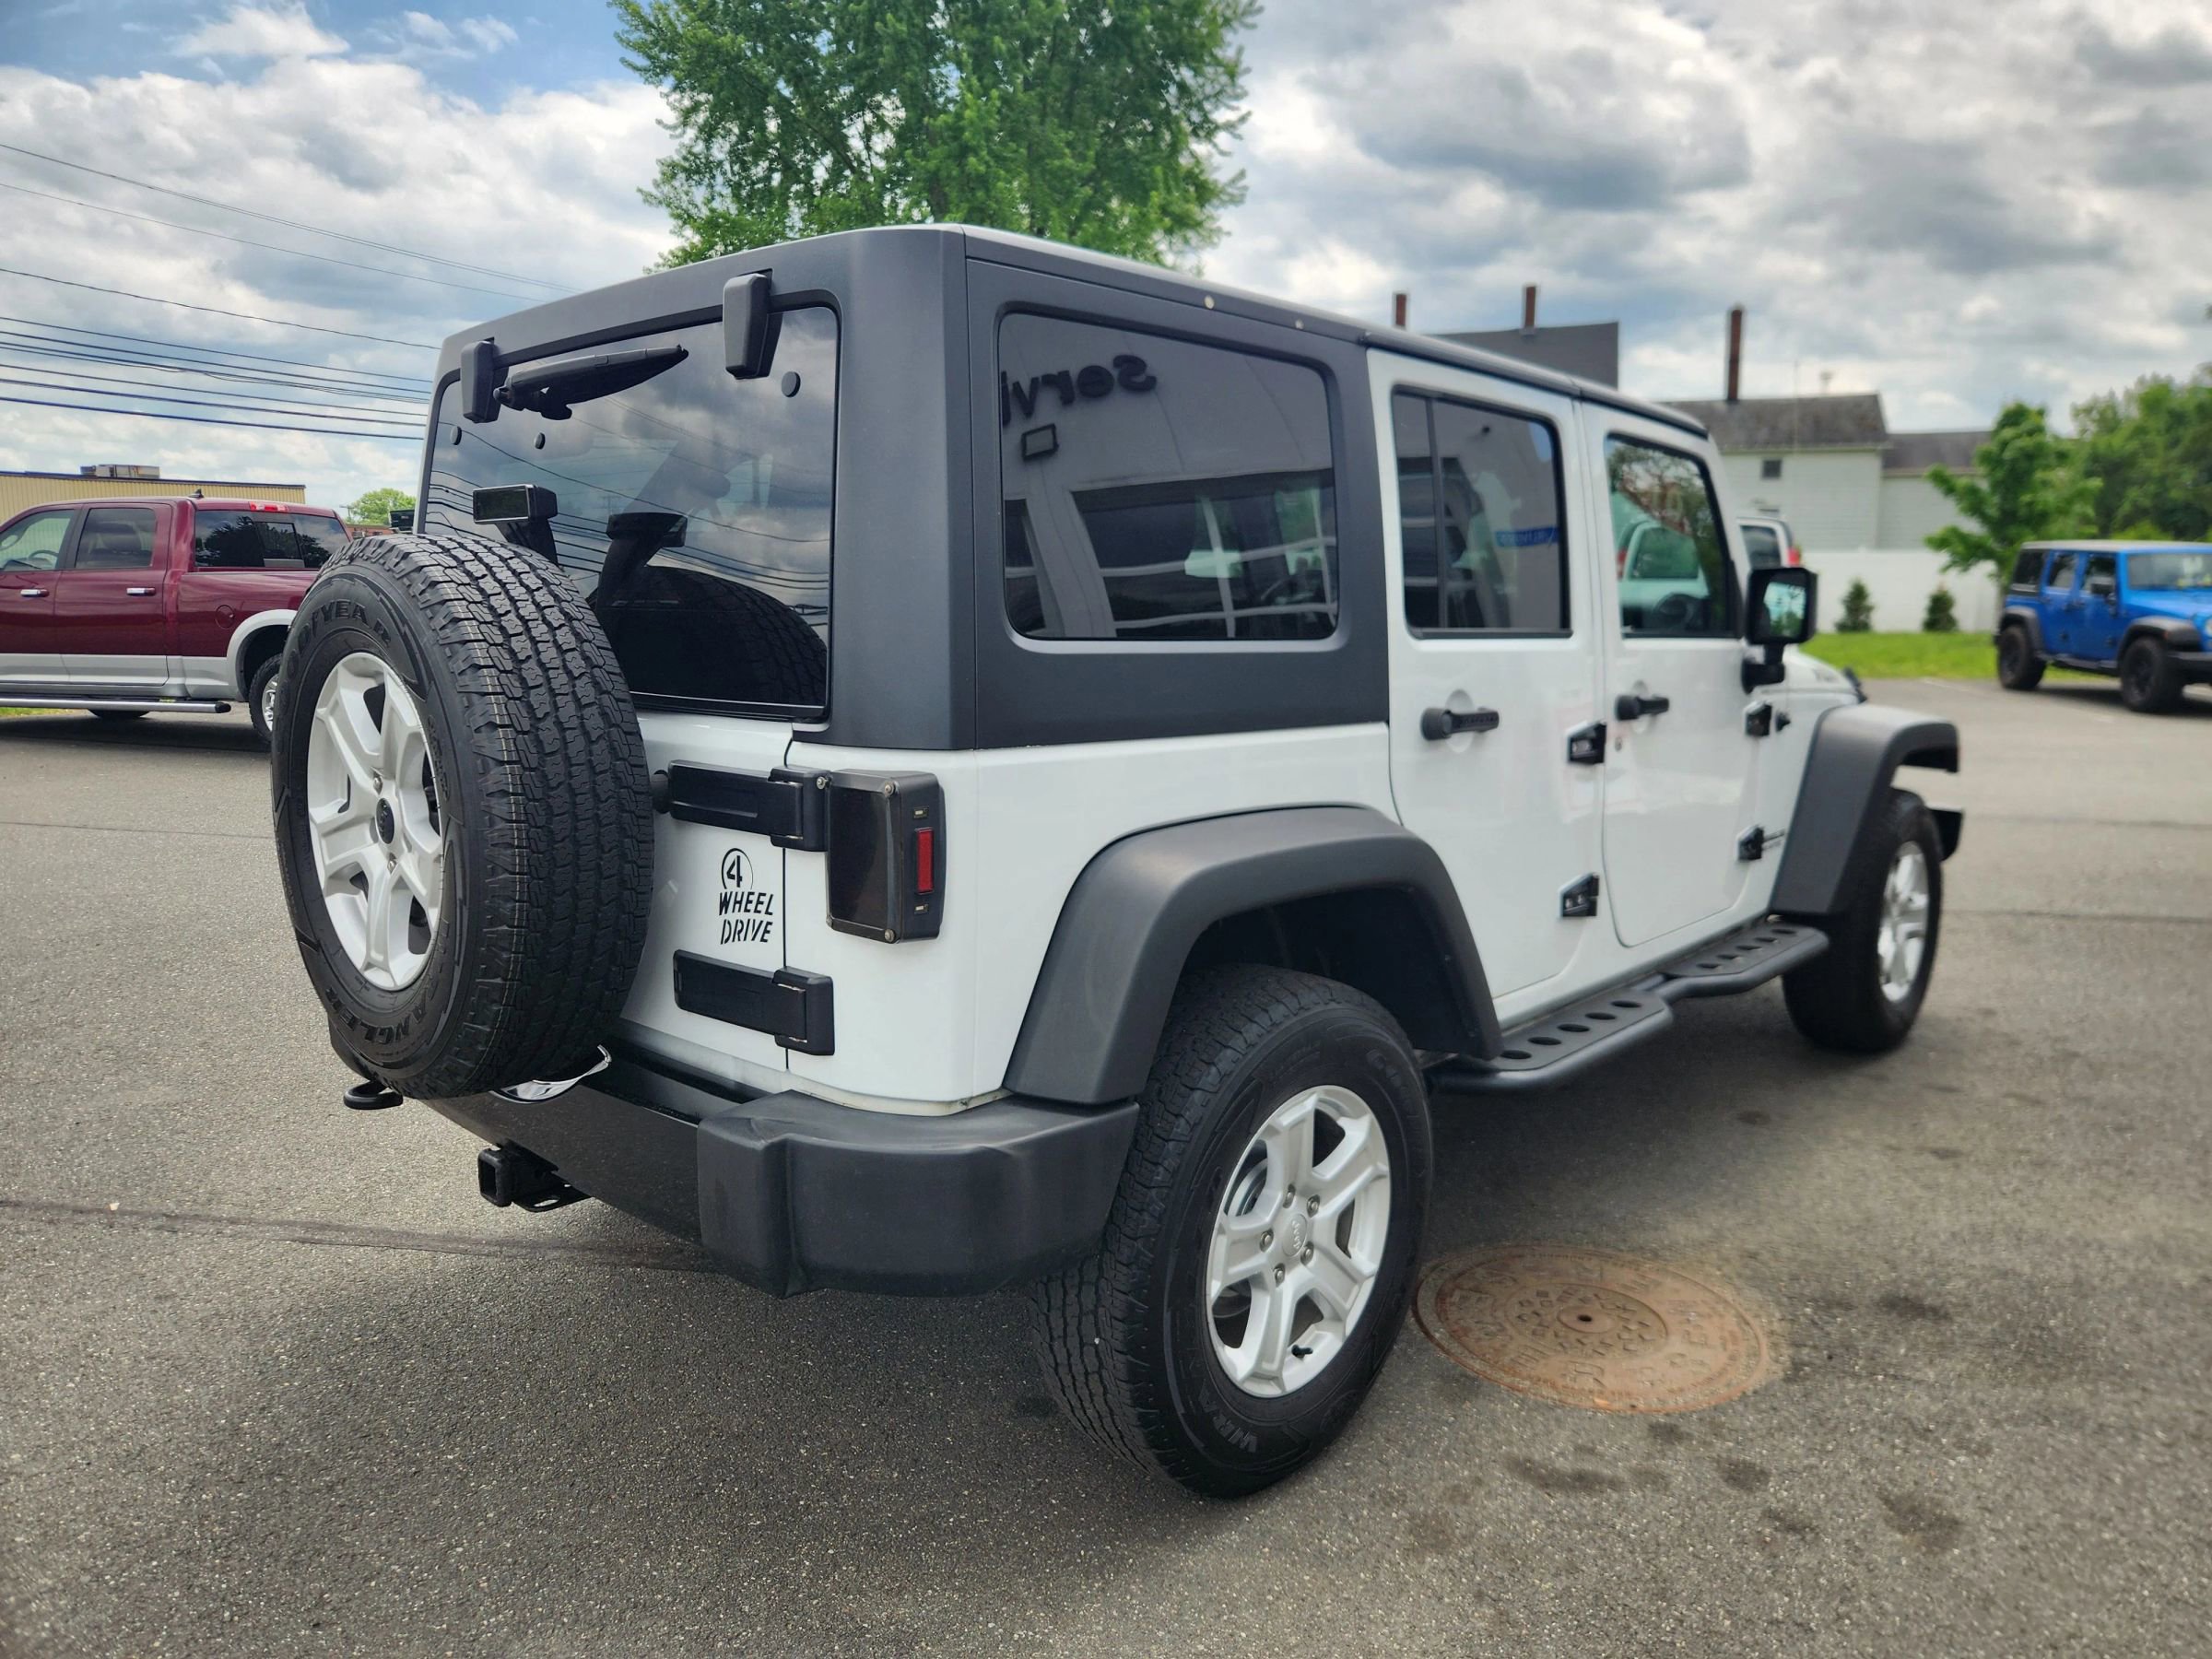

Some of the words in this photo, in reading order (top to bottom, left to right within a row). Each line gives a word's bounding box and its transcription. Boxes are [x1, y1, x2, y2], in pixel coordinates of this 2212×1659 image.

[726, 854, 743, 888] 4
[719, 890, 773, 916] WHEEL
[720, 918, 773, 945] DRIVE
